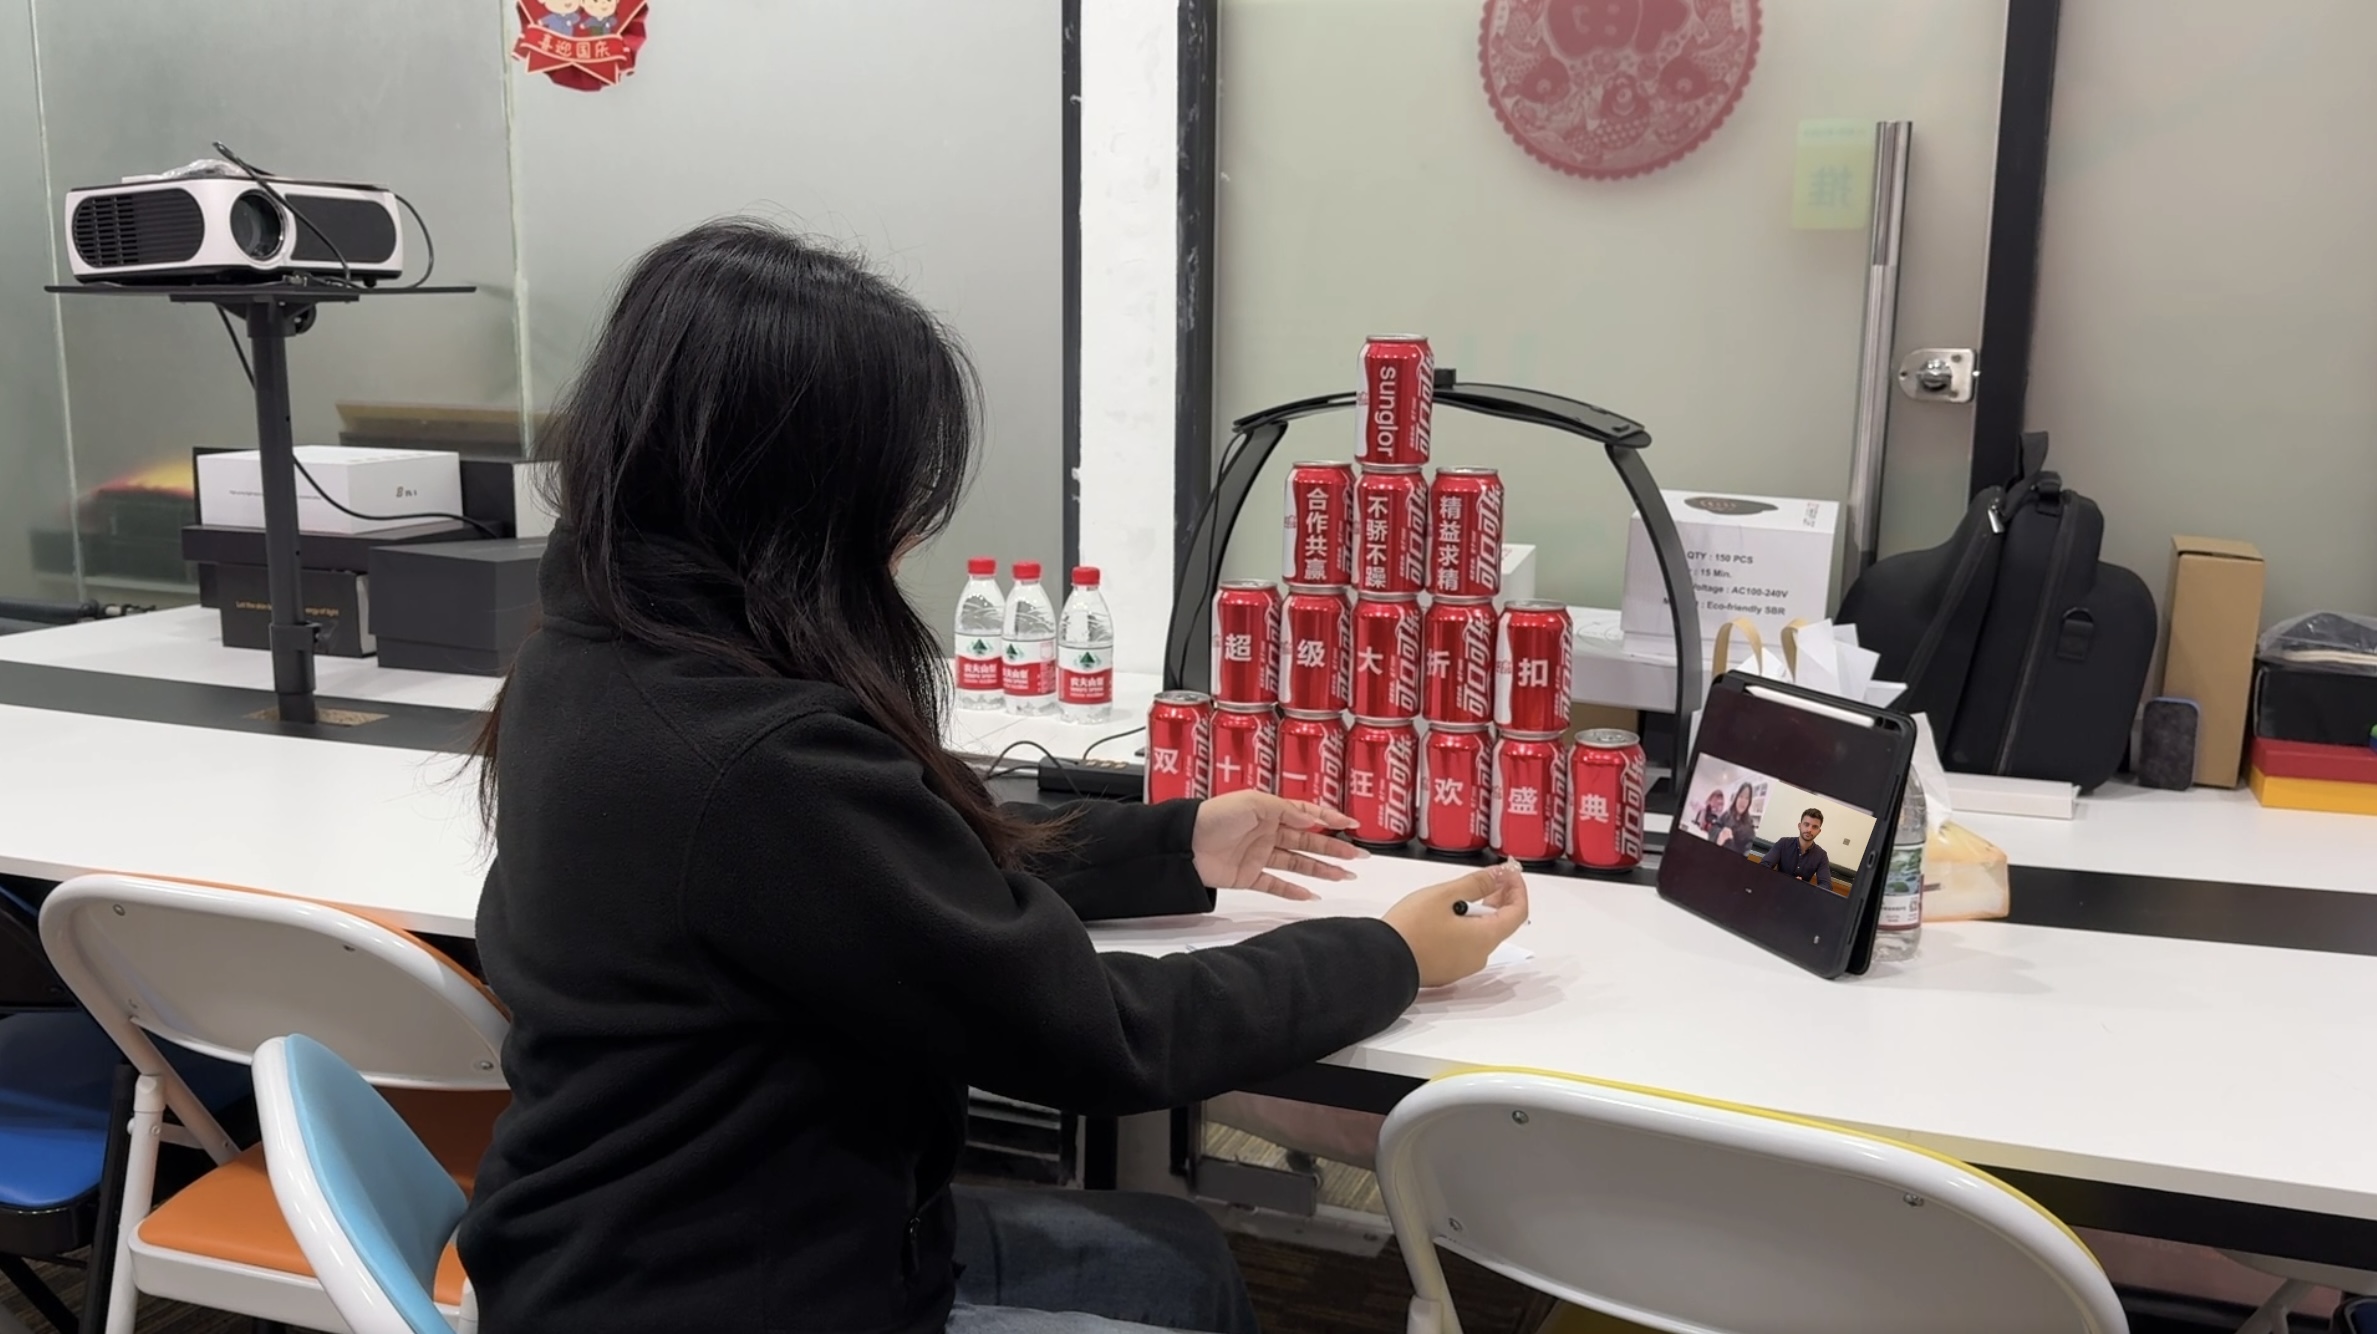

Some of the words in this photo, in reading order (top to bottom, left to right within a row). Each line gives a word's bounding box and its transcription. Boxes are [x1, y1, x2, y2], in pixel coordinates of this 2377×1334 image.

[1374, 366, 1399, 457] sunglor
[1304, 487, 1329, 580] 合作共赢
[1365, 496, 1388, 588] 不骄不躁
[1437, 496, 1462, 591] 精益求精
[1686, 551, 1707, 560] QTY
[1715, 553, 1731, 563] 150
[1733, 555, 1753, 564] PCS
[1700, 568, 1711, 577] 15
[1707, 601, 1762, 615] Eco-friendly
[1764, 606, 1786, 615] SBR
[1225, 633, 1252, 661] 超
[1297, 639, 1325, 668] 级
[1357, 646, 1383, 675] 大
[1427, 648, 1450, 679] 折
[1518, 658, 1548, 687] 扣
[1153, 747, 1179, 775] 双
[1216, 755, 1240, 783] 十
[1282, 771, 1308, 780] 一
[1350, 768, 1374, 797] 狂
[1434, 778, 1463, 806] 欢
[1508, 786, 1538, 815] 盛
[1579, 793, 1609, 824] 典
